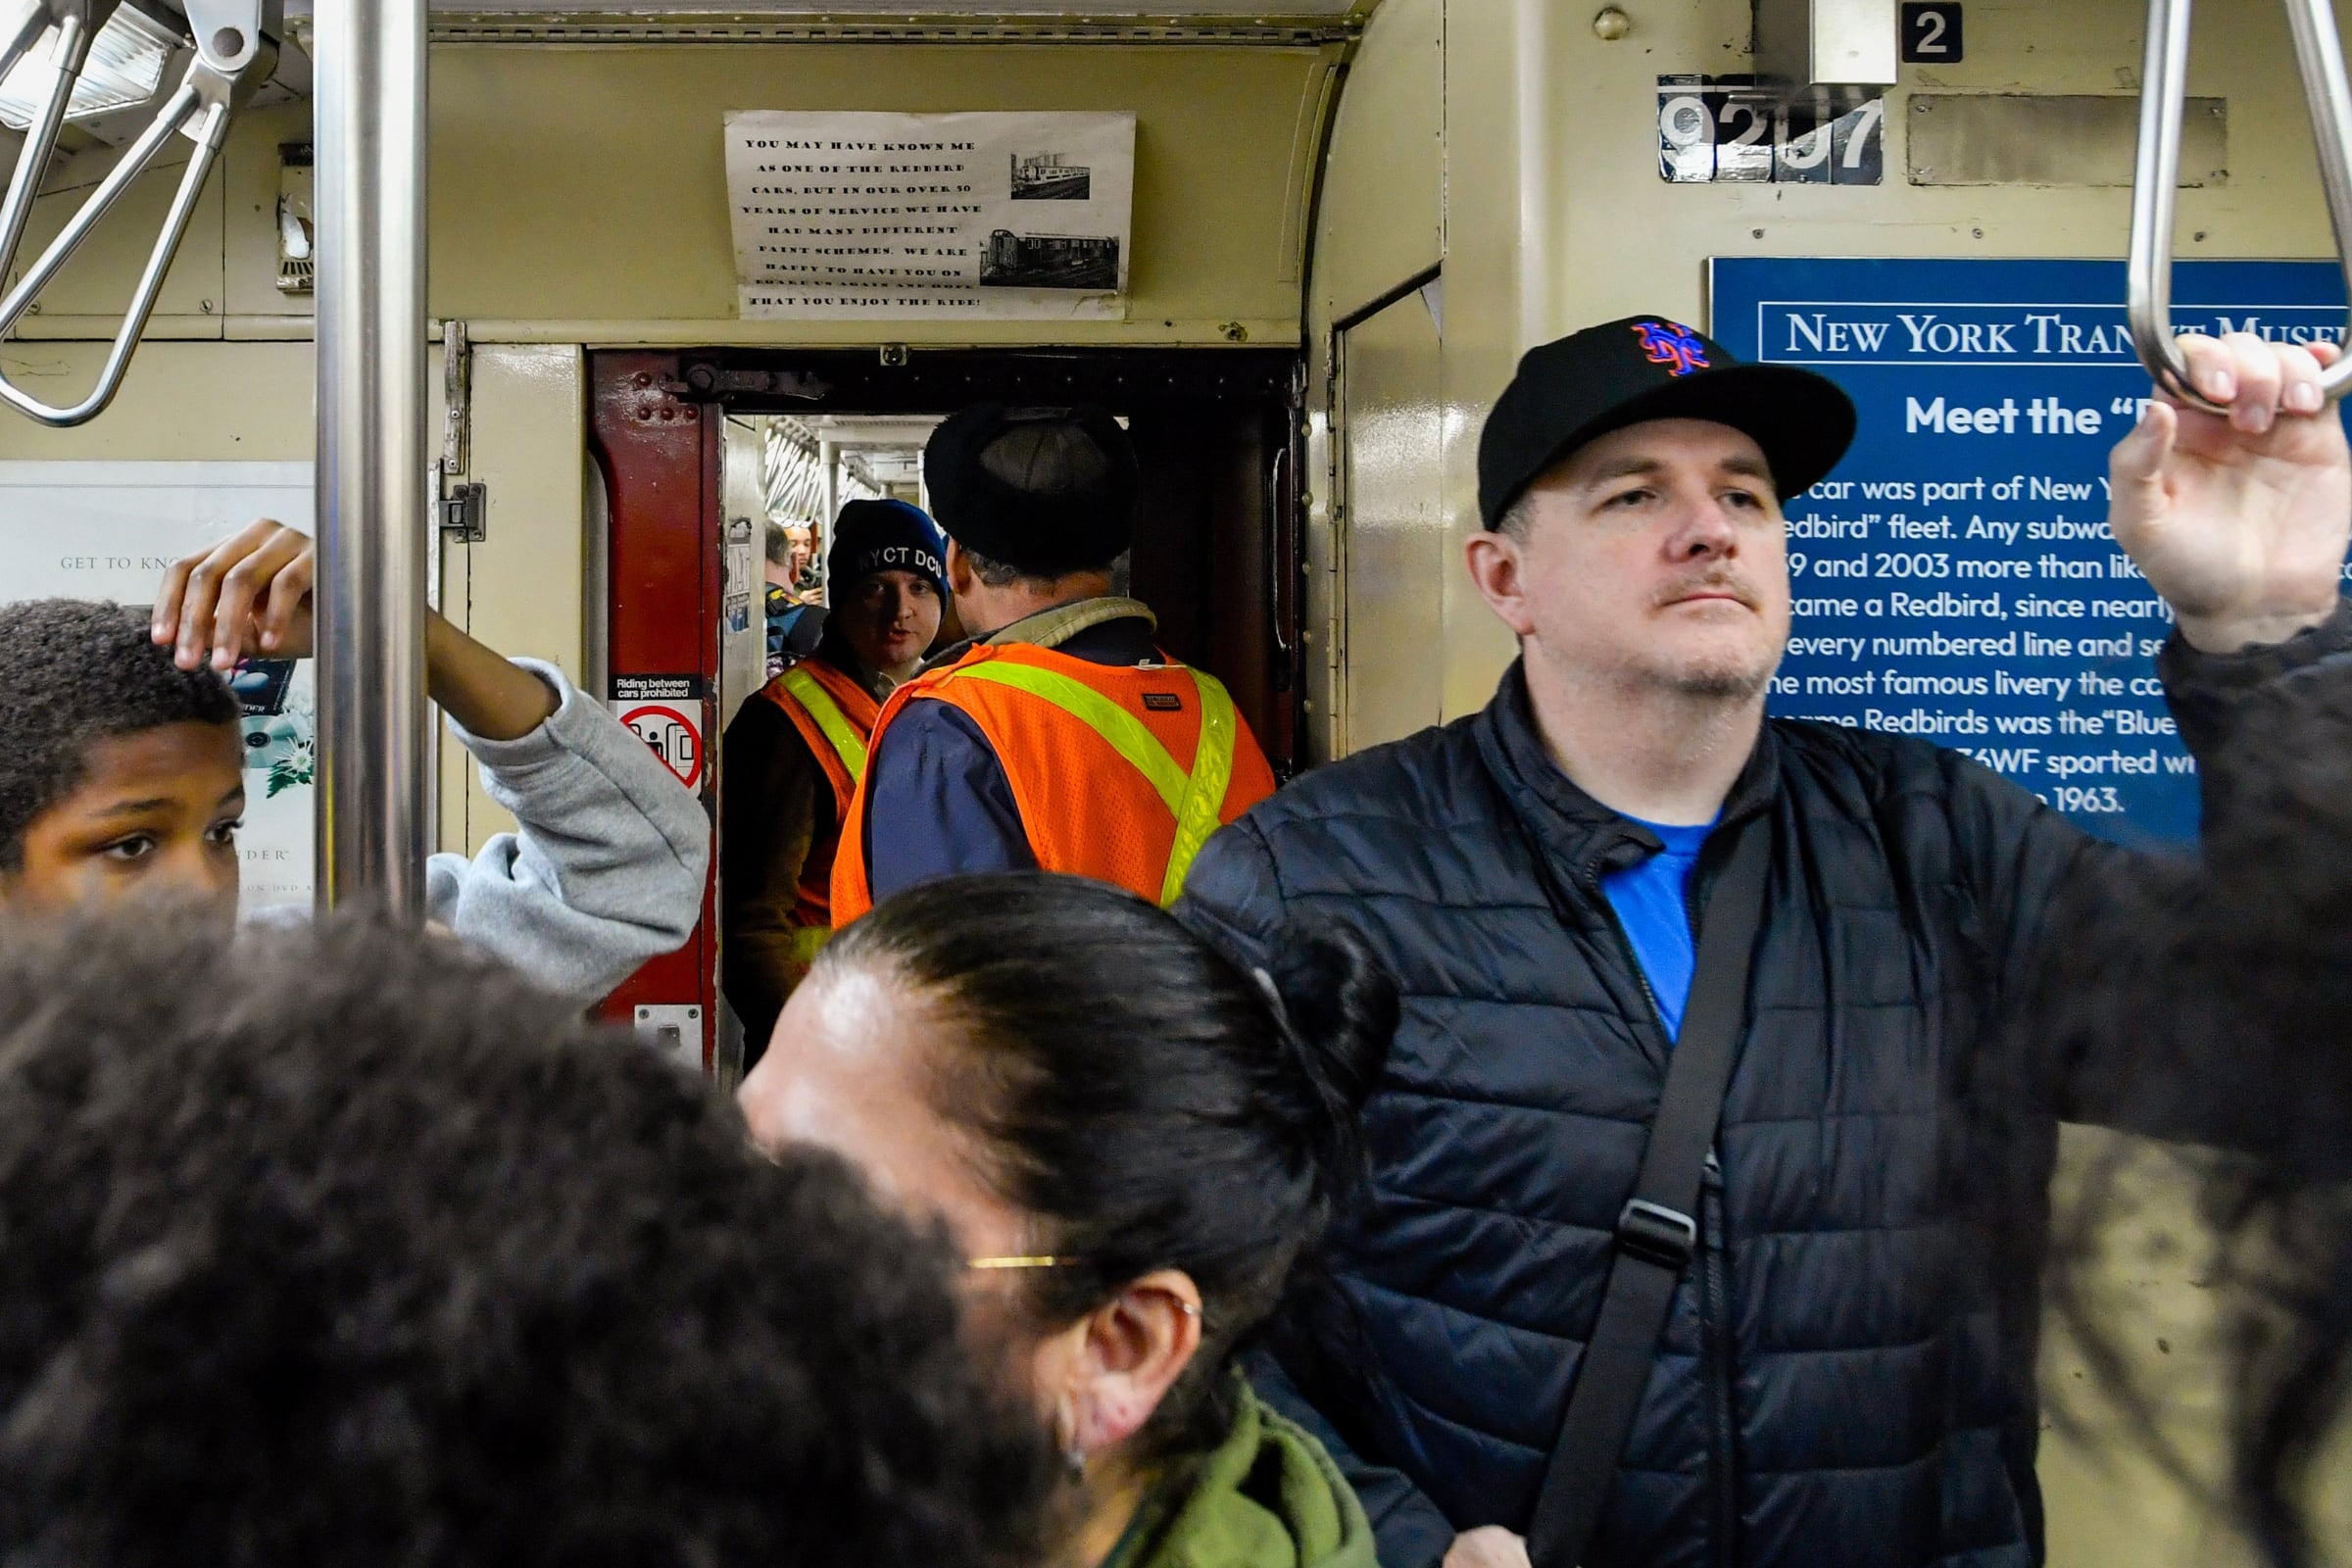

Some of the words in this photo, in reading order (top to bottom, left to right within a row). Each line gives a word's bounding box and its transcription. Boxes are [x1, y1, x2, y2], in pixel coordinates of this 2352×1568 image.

[1917, 12, 1947, 53] 2
[890, 164, 964, 172] REDBIRD
[765, 264, 819, 272] HAPPY
[1786, 314, 1890, 352] NEW
[1896, 315, 2018, 353] YORK
[1907, 398, 2019, 433] Meet
[2027, 398, 2101, 434] the
[1809, 482, 1855, 499] car
[1862, 483, 1915, 500] was
[1924, 477, 1985, 506] part
[1992, 475, 2024, 500] of
[2031, 477, 2091, 500] New
[1887, 514, 1957, 539] fleet.
[1966, 515, 2021, 545] Any
[2027, 515, 2116, 540] subwa
[61, 558, 98, 569] GET
[106, 558, 131, 569] TO
[1814, 553, 1868, 578] and
[1874, 553, 1950, 578] 2003
[1957, 560, 2032, 578] more
[2037, 554, 2102, 578] than
[1865, 599, 1883, 616] a
[1890, 592, 2008, 620] Redbird,
[2015, 594, 2085, 617] since
[1788, 638, 1866, 662] every
[1873, 631, 2017, 656] numbered
[2024, 632, 2072, 657] line
[2078, 632, 2132, 657] and
[616, 678, 647, 690] Riding
[648, 679, 690, 688] between
[617, 689, 639, 698] cars
[640, 688, 689, 699] prohibited
[1806, 670, 1876, 695] most
[1882, 669, 1988, 695] famous
[1995, 670, 2071, 702] livery
[2078, 671, 2125, 696] the
[1865, 709, 1988, 733] Redbirds
[1995, 716, 2052, 734] was
[2046, 749, 2157, 780] sported
[2055, 787, 2125, 812] 1963.
